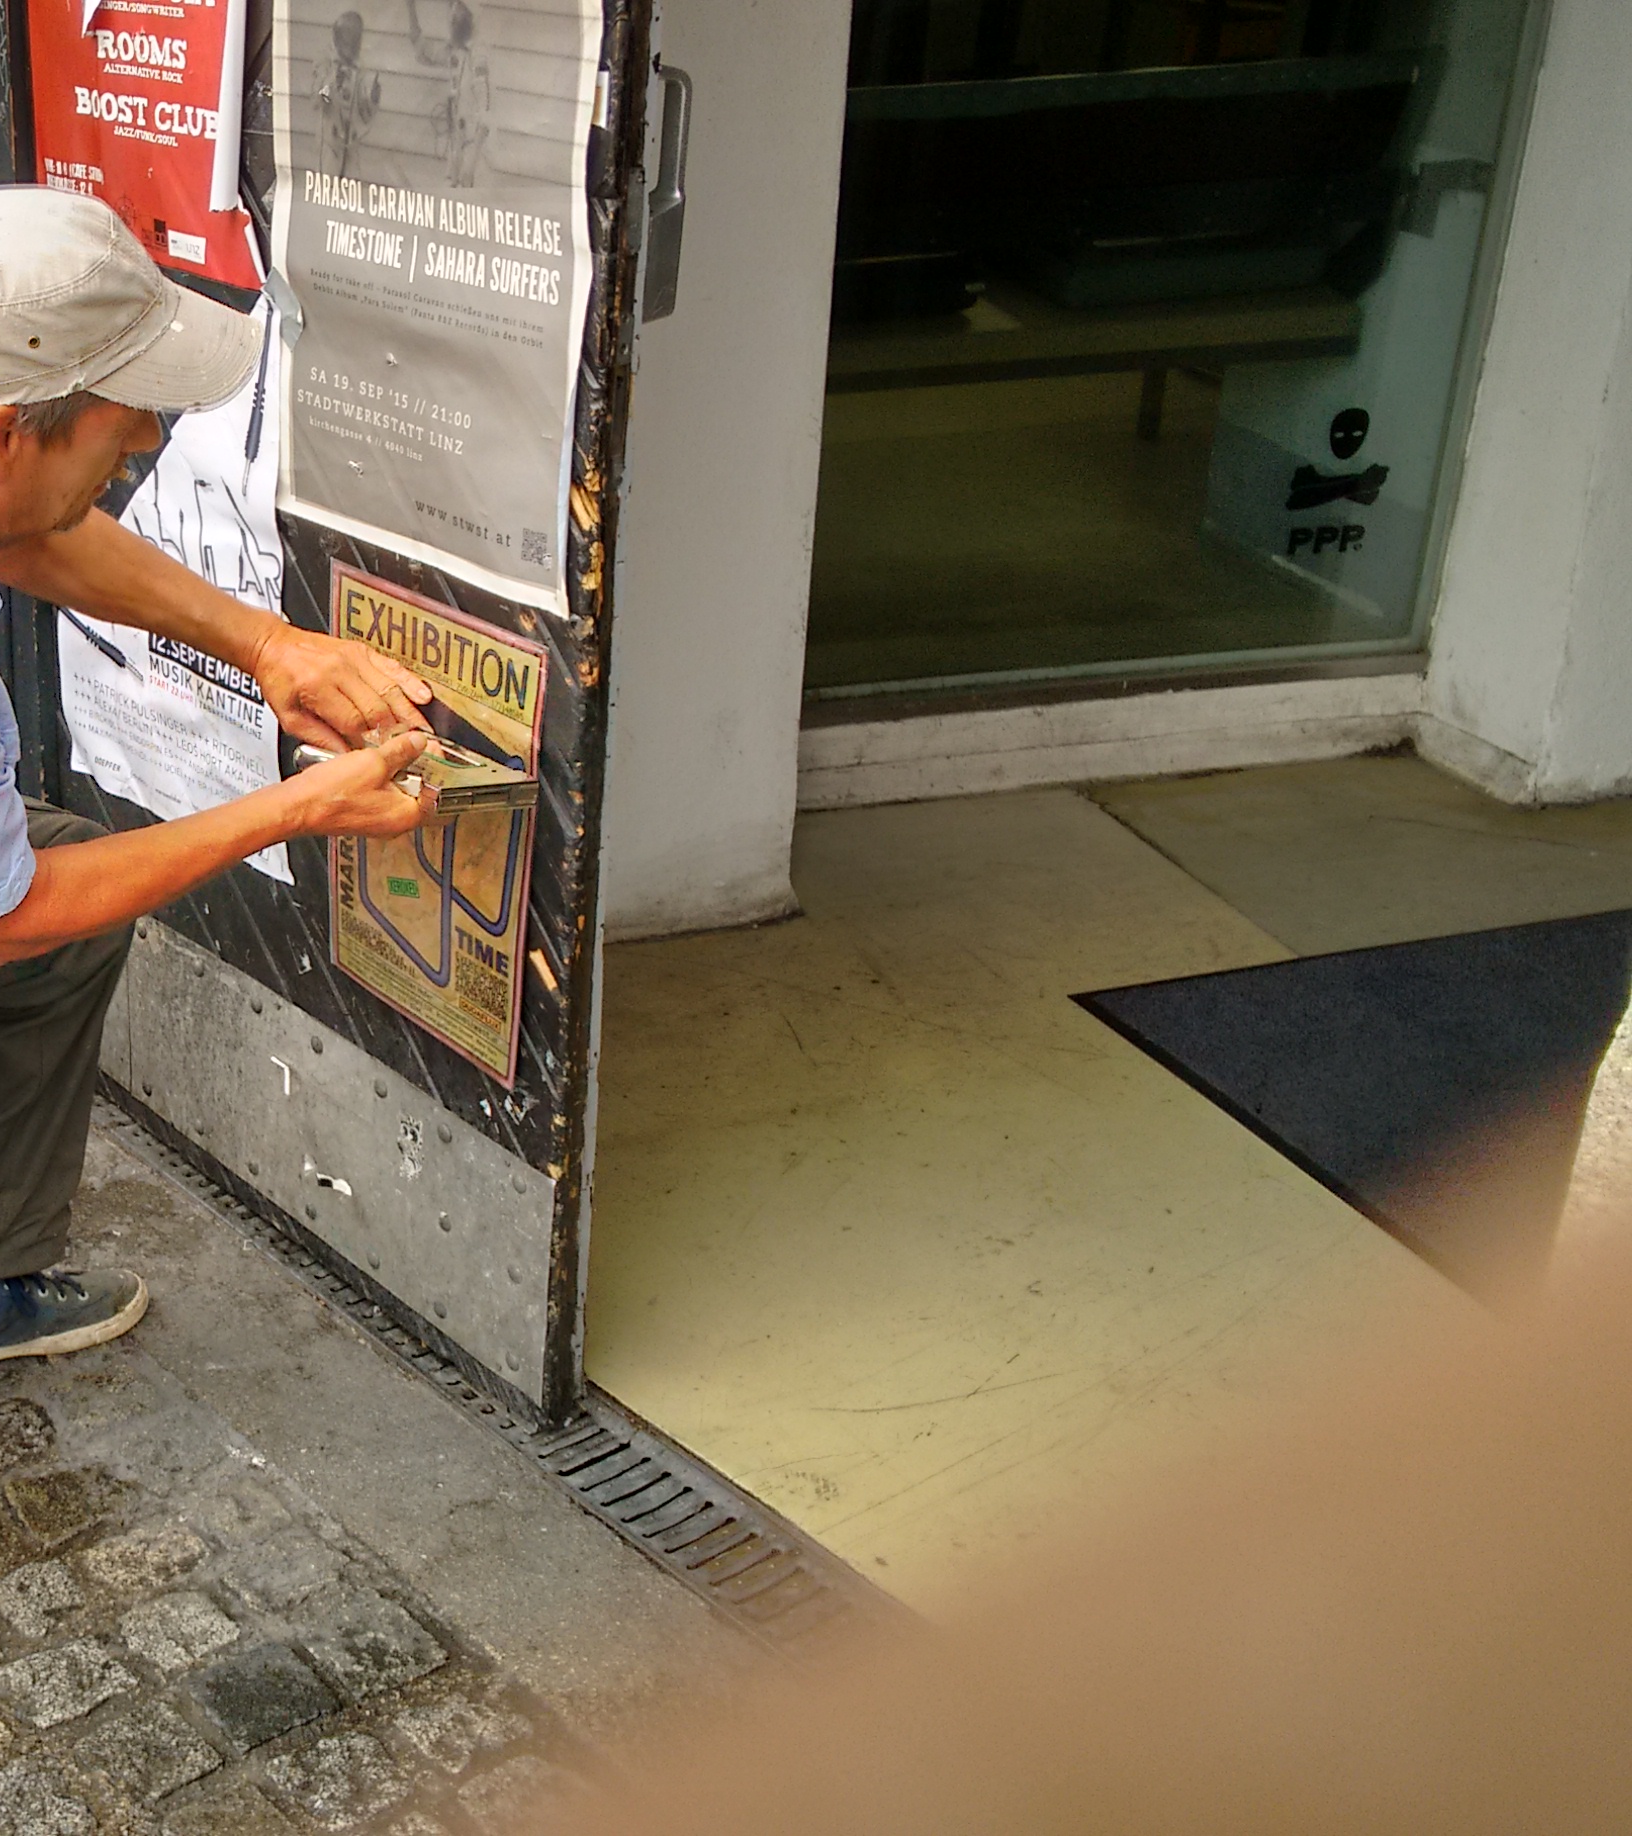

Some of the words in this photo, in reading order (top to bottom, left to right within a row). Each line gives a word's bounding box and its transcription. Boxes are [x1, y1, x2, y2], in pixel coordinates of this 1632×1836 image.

[96, 29, 187, 70] ROOMS
[103, 62, 161, 81] ALTERNATIVE
[162, 72, 183, 84] ROCK
[74, 86, 148, 126] BOOST
[154, 101, 219, 140] CLUB
[113, 125, 179, 147] JAZZ/FUNK/SOUL
[305, 170, 365, 214] PARASOL
[369, 183, 434, 229] CARAVAN
[439, 198, 490, 241] ALBUM
[494, 209, 562, 257] RELEASE
[310, 268, 331, 282] Ready
[332, 272, 343, 284] for
[345, 276, 361, 288] take
[382, 285, 411, 301] Parasol
[413, 292, 445, 309] Caravan
[326, 220, 404, 269] TIMESTONE
[424, 242, 485, 288] SAHARA
[490, 256, 560, 305] SURFERS
[335, 288, 358, 302] Album
[490, 326, 500, 339] in
[502, 330, 518, 342] den
[520, 333, 544, 349] Orbit
[297, 389, 424, 442] STADTWERKSTATT
[429, 431, 464, 456] LINZ
[310, 367, 327, 384] SA
[333, 373, 354, 392] 19.
[359, 381, 384, 400] SEP
[413, 398, 426, 416] //
[431, 404, 472, 430] 21:00
[309, 416, 364, 442] kirchengasse
[365, 432, 372, 445] 4
[406, 446, 423, 462] linz
[346, 589, 530, 710] EXHIBITION
[149, 675, 169, 692] START
[170, 685, 180, 698] 22
[149, 654, 193, 691] MUSIK
[196, 679, 264, 730] KANTINE
[93, 679, 132, 709] PATRICK
[131, 699, 188, 737] PULSINGER
[212, 738, 268, 780] RITORNELL
[455, 925, 510, 977] TIME
